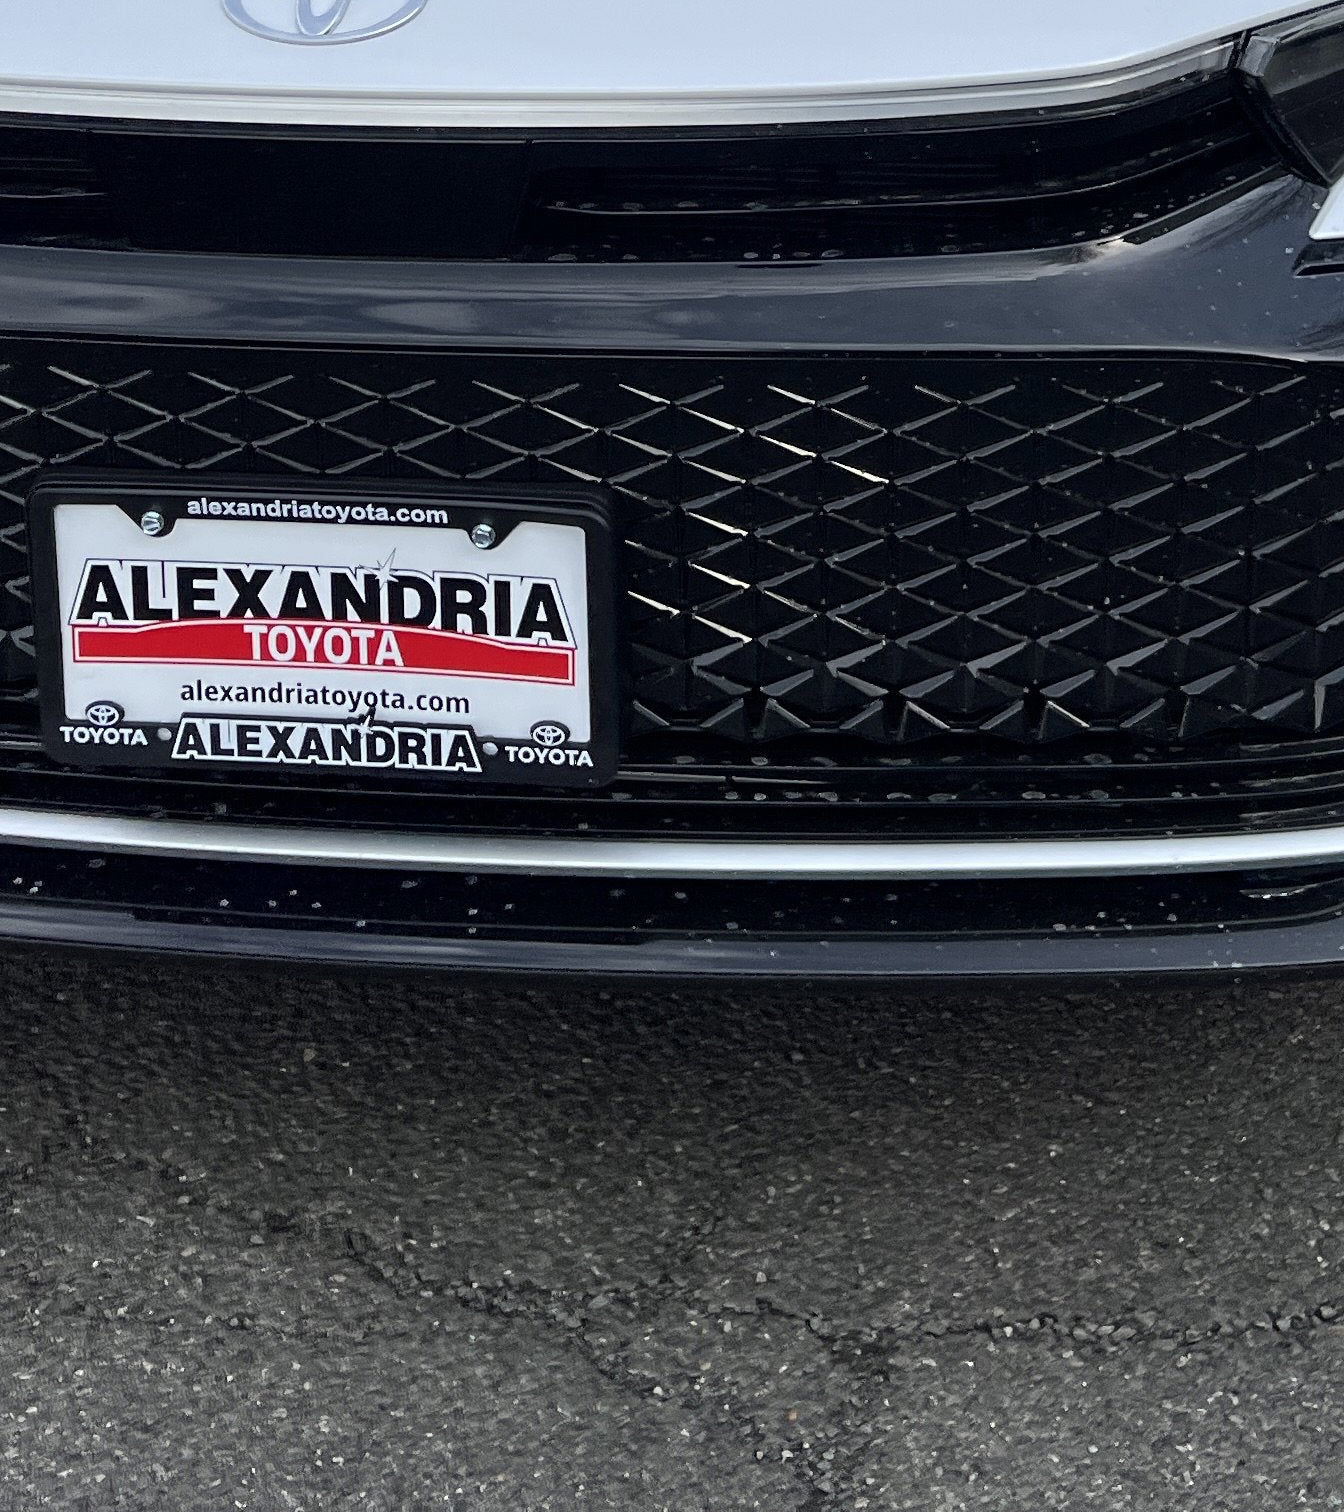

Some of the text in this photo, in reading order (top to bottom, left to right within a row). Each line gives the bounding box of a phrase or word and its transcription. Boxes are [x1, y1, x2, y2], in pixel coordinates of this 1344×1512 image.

[186, 497, 449, 525] alexandriatoyota.com
[72, 561, 573, 646] ALEXANDRIA
[243, 623, 405, 667] TOYOTA
[180, 679, 471, 714] alexandriatoyota.com
[59, 725, 149, 746] TOYOTA
[173, 719, 481, 772] ALEXANDRIA
[504, 745, 594, 768] TOYOTA
